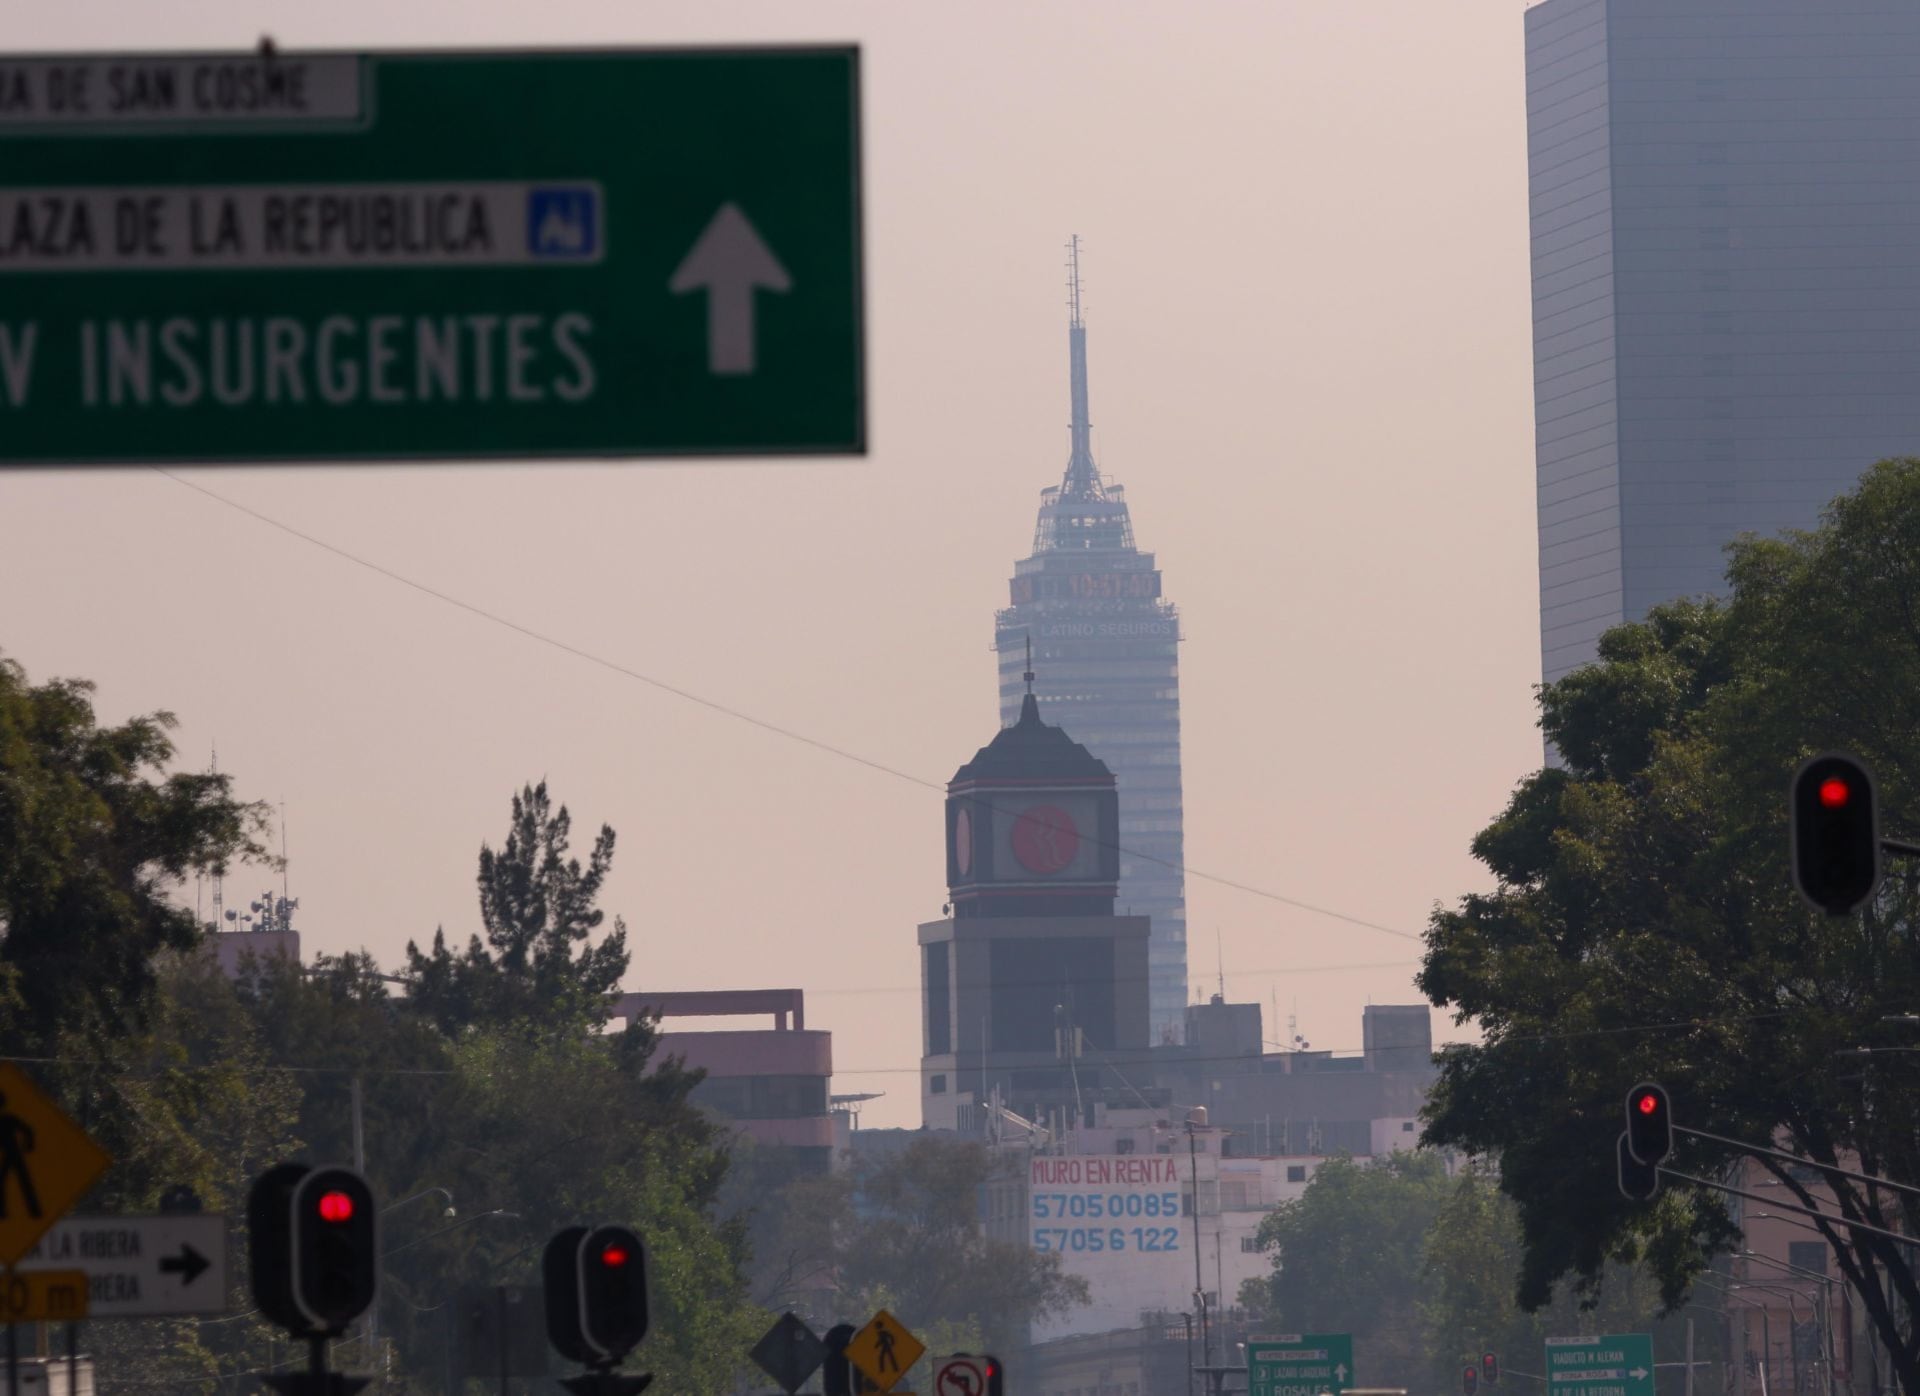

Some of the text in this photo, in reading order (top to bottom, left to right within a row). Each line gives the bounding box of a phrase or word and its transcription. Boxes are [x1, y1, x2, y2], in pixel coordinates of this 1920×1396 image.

[44, 66, 87, 111] DE
[108, 65, 175, 111] SAN
[193, 64, 307, 110] COSME
[115, 197, 166, 255] DE
[190, 195, 244, 254] LA
[264, 192, 494, 254] REPUBLICA
[81, 312, 596, 406] INSURGENTES
[1041, 622, 1170, 637] LATINO SEGUROS
[1032, 1158, 1177, 1184] MURO EN RENTA
[50, 1231, 73, 1260] LA
[79, 1229, 141, 1258] RIBERA
[47, 1285, 76, 1312] m
[1552, 1351, 1586, 1364] VIADUCTO
[1597, 1350, 1625, 1362] ALEMAN
